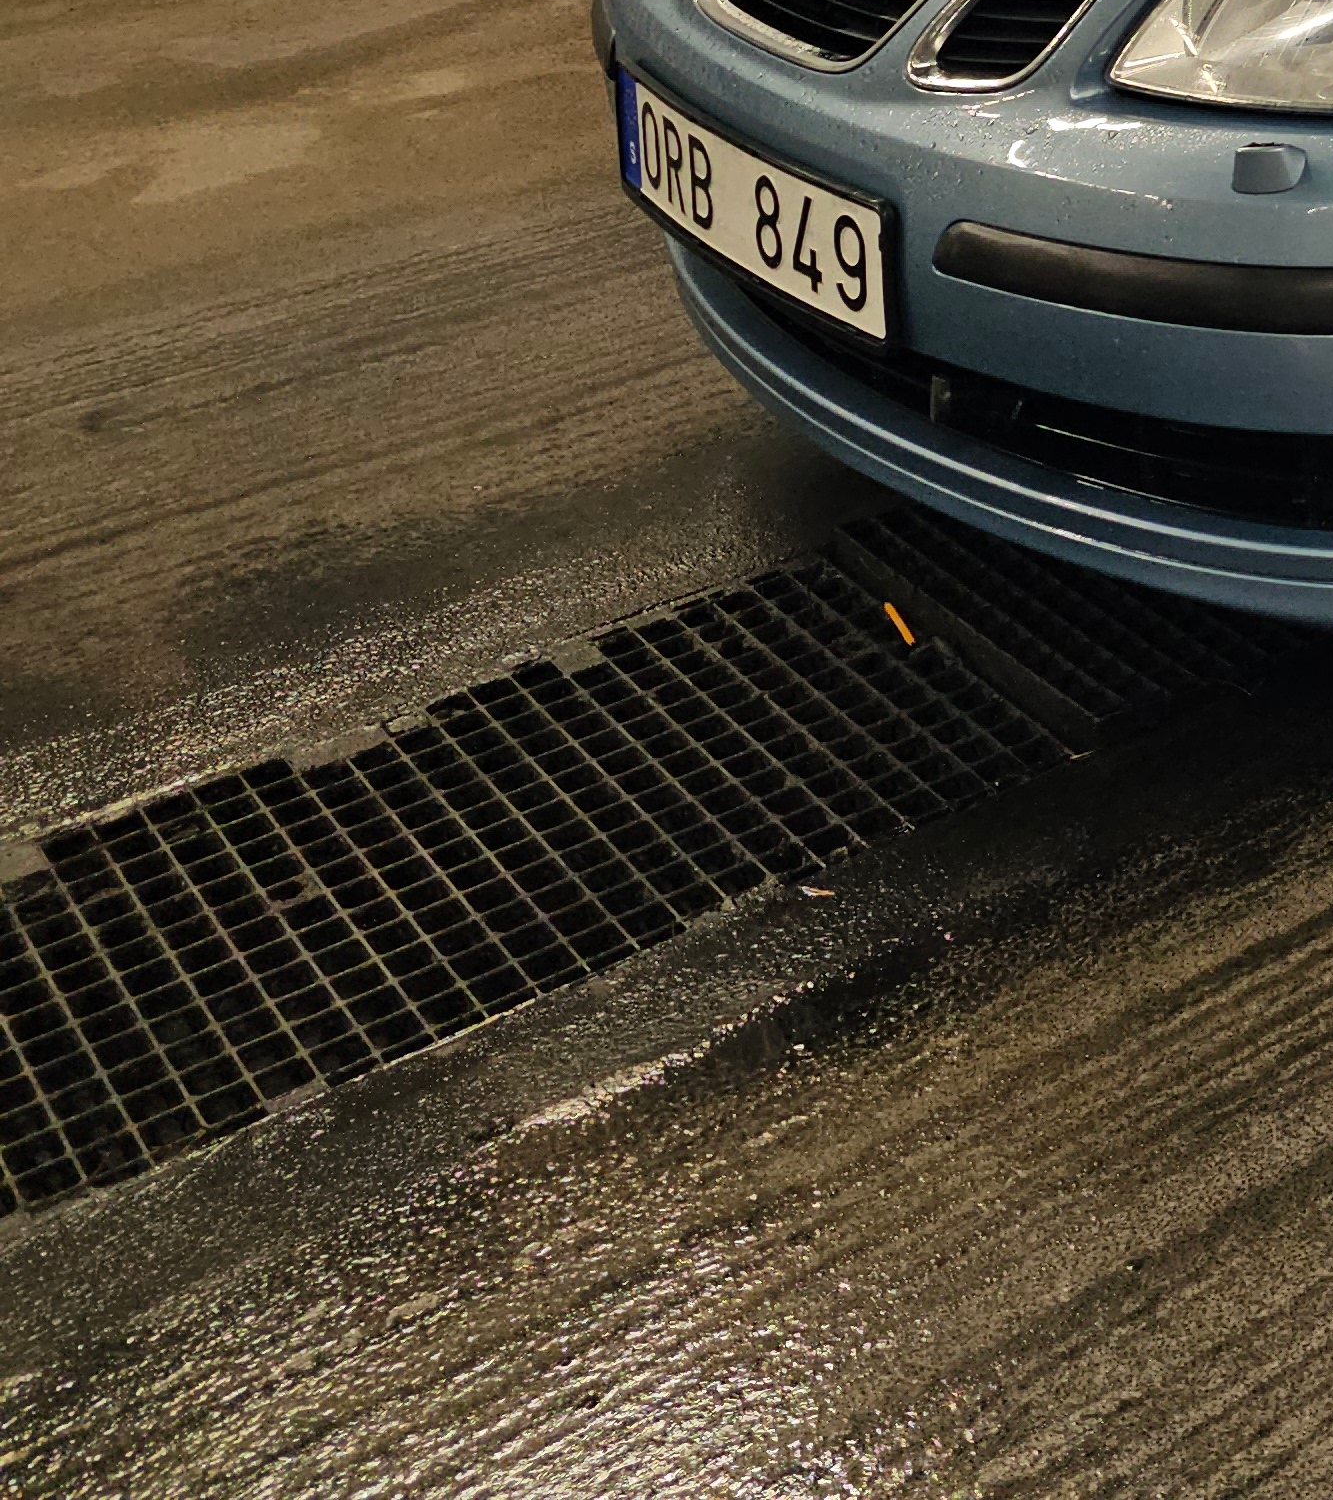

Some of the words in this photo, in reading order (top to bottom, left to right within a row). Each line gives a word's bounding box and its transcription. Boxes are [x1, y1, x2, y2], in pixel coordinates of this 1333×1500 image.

[629, 141, 637, 165] S
[641, 101, 714, 230] ORB
[754, 174, 868, 312] 849
